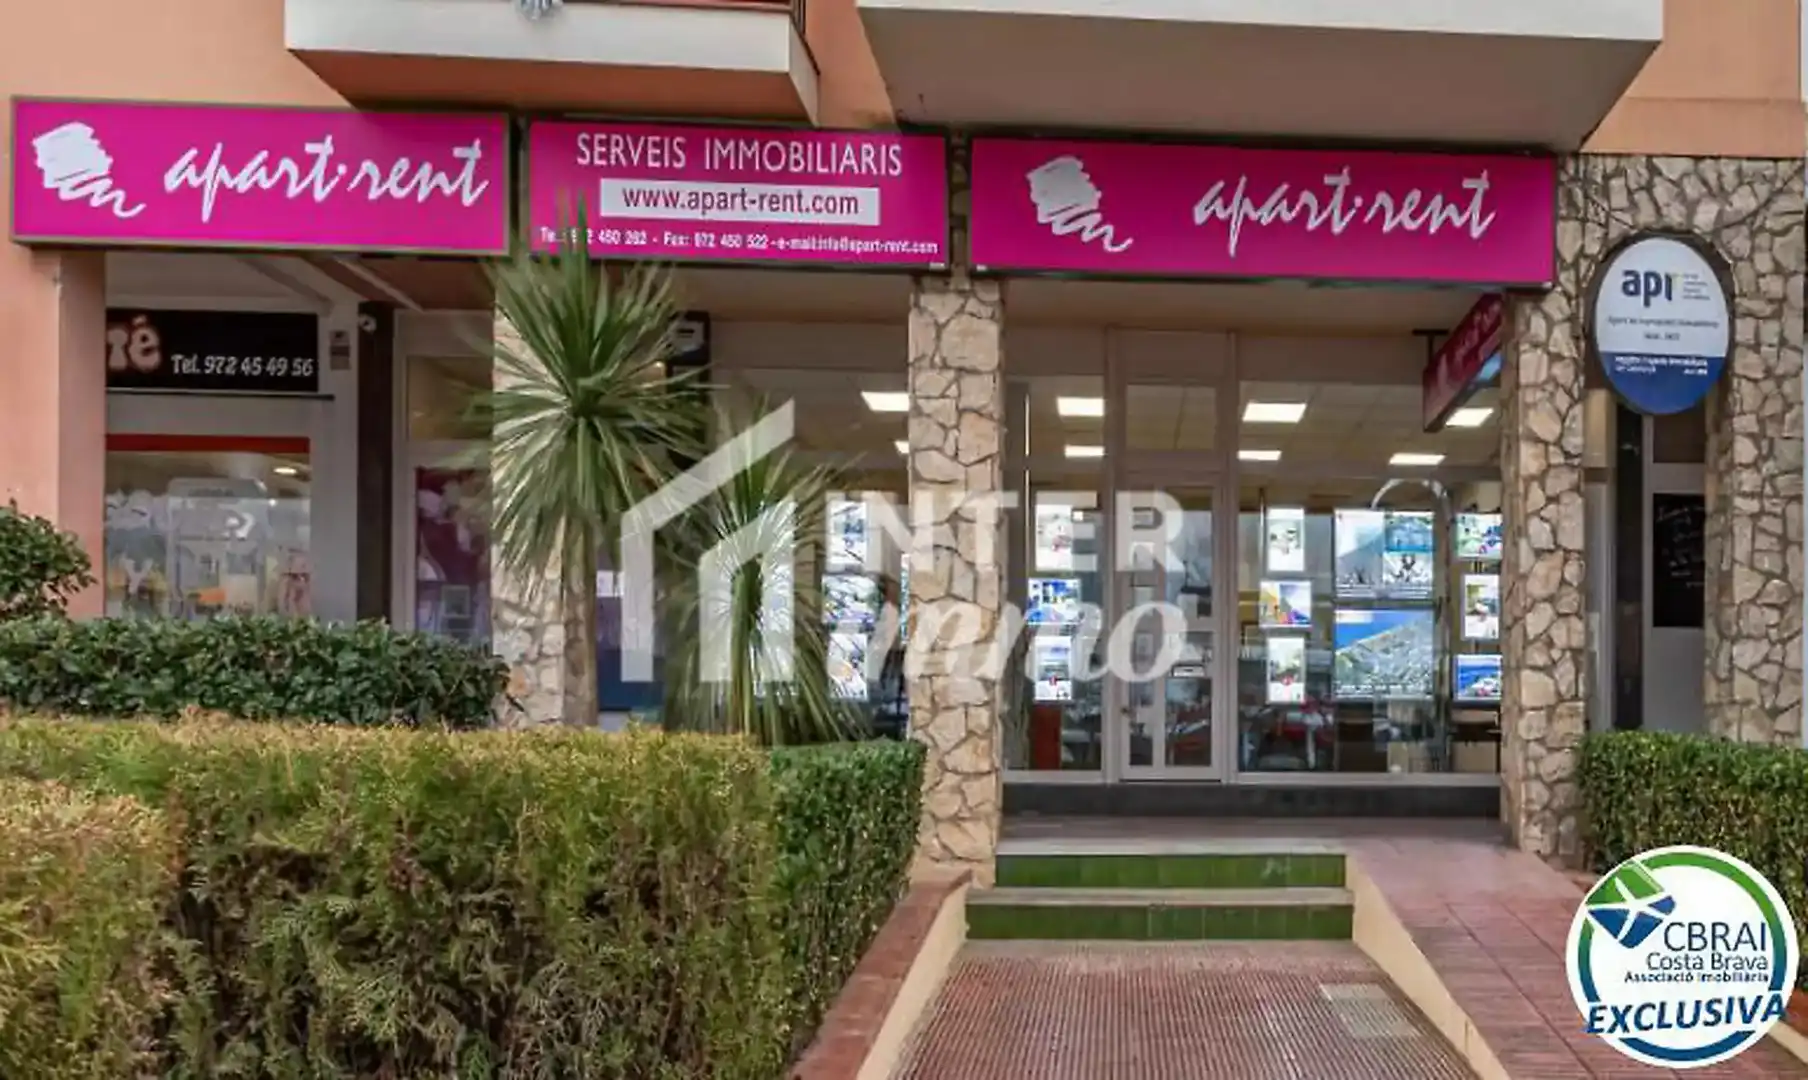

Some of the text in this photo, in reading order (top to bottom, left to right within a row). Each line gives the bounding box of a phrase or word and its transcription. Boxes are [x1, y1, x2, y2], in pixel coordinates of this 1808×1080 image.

[576, 132, 903, 177] SERVEIS IMMOBILIARIS
[622, 185, 860, 217] www.apart-rent.com
[171, 353, 200, 375] Tel.
[203, 354, 237, 376] 972
[240, 355, 262, 377] 45
[265, 356, 288, 377] 49
